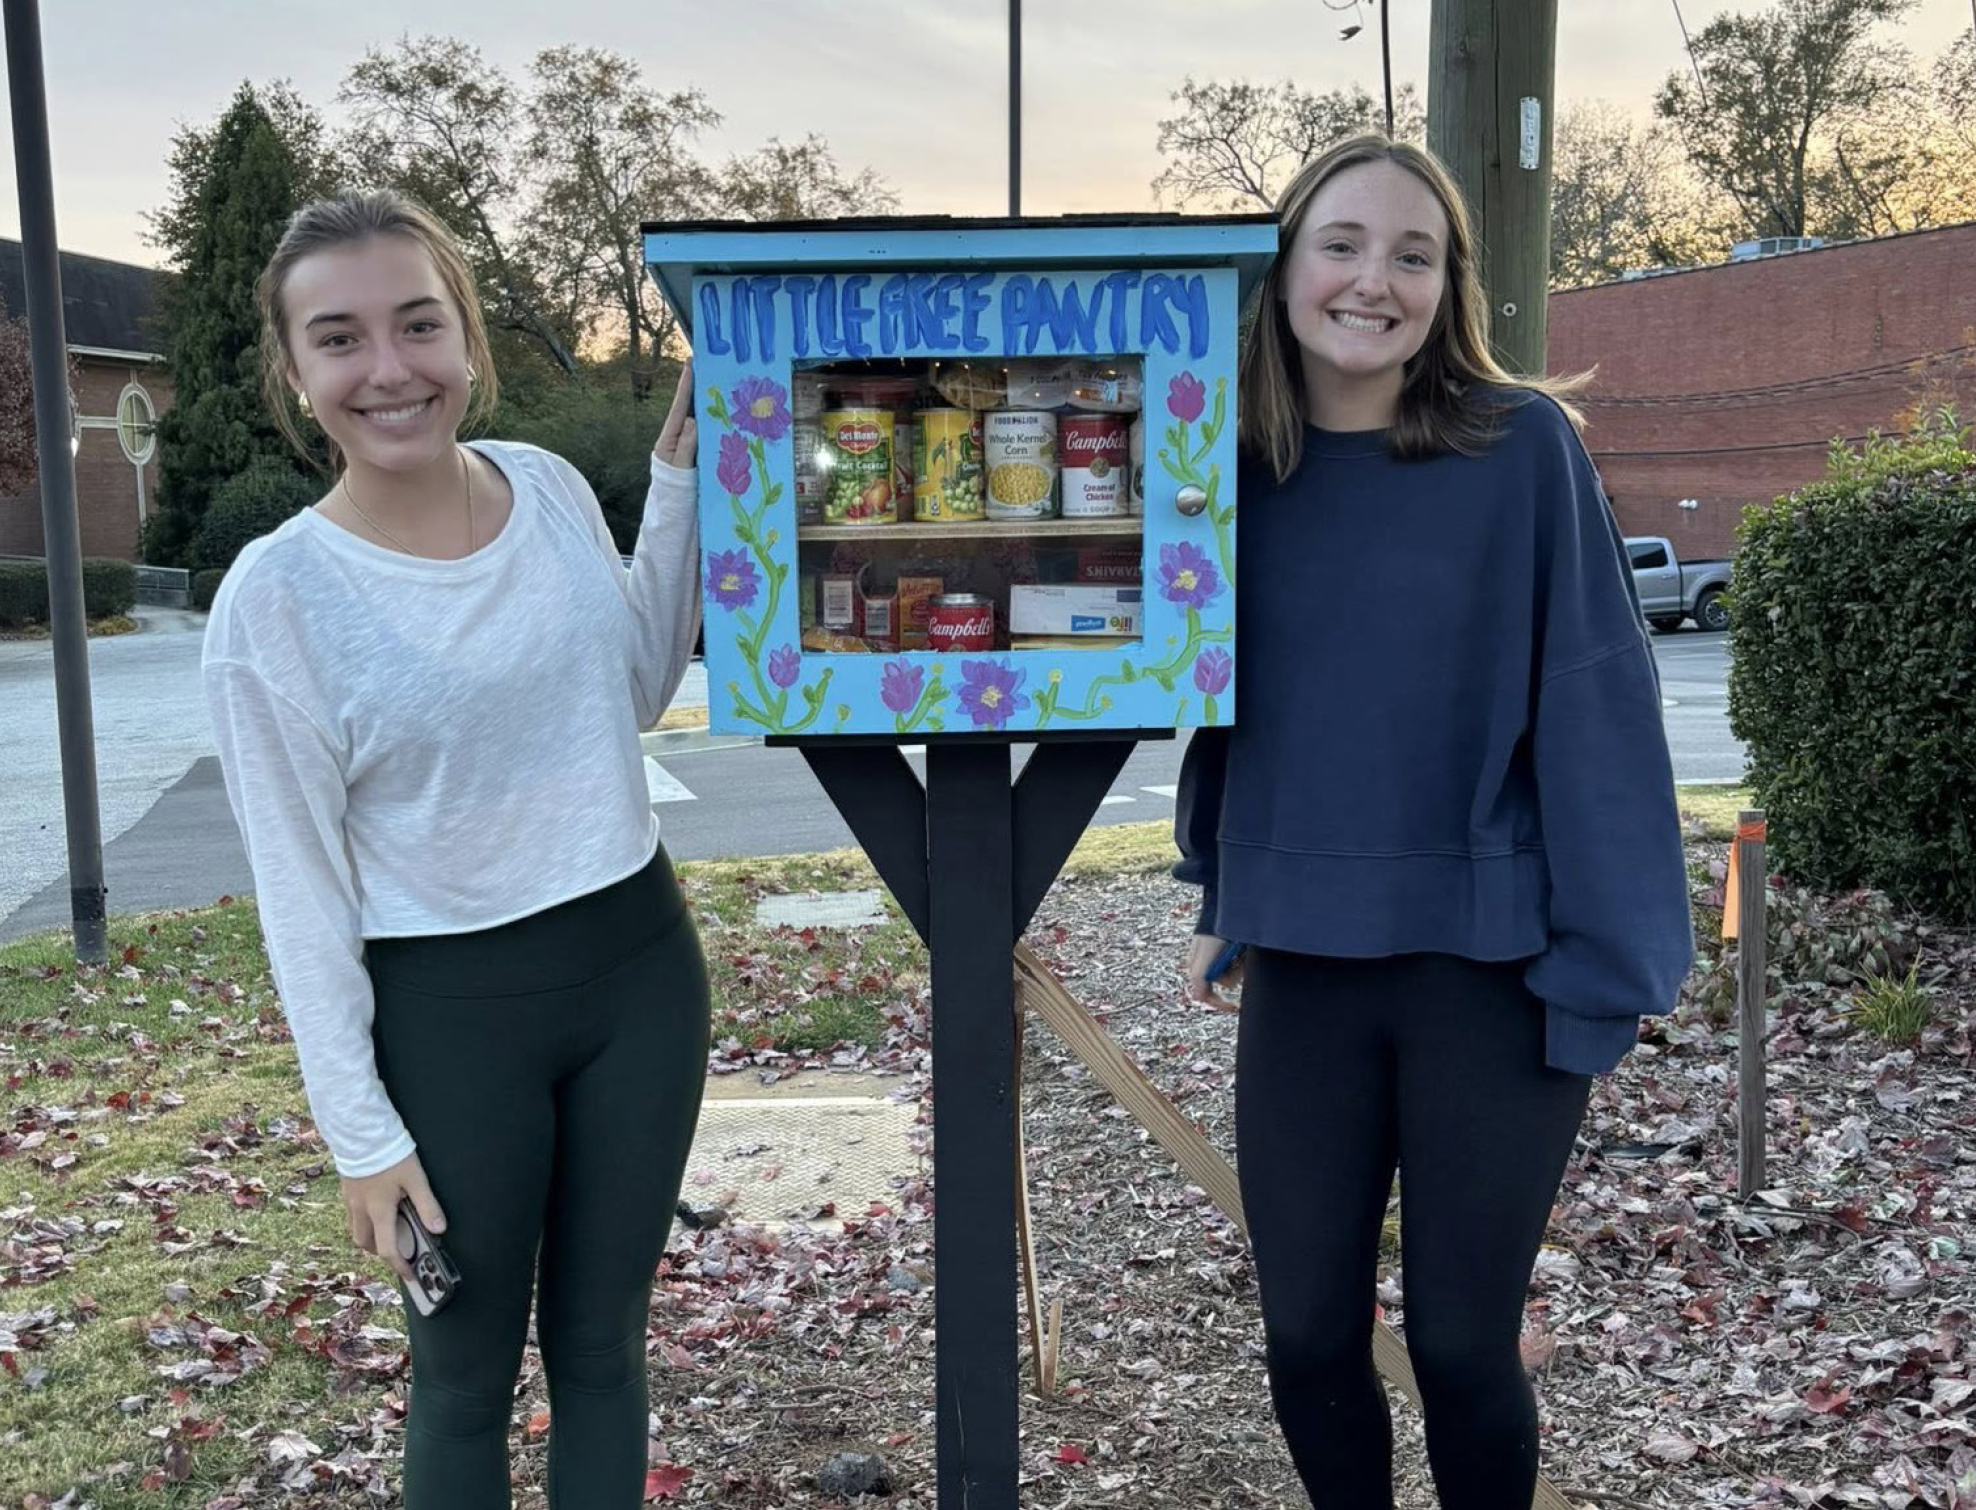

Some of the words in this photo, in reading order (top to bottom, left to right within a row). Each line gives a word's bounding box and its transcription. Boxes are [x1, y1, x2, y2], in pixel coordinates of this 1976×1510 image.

[701, 274, 875, 364] LITTLE
[879, 273, 996, 355] FREE
[1002, 271, 1210, 360] PANTRY
[994, 416, 1011, 425] FOOD
[1022, 416, 1038, 425] LION
[840, 431, 852, 441] Del
[853, 431, 878, 441] Monte
[988, 433, 1015, 444] Whole
[1017, 433, 1047, 443] Kernel
[1005, 445, 1028, 455] Corn
[856, 461, 888, 471] Cocktail
[1083, 484, 1107, 493] Cream
[1086, 493, 1114, 502] Chicken
